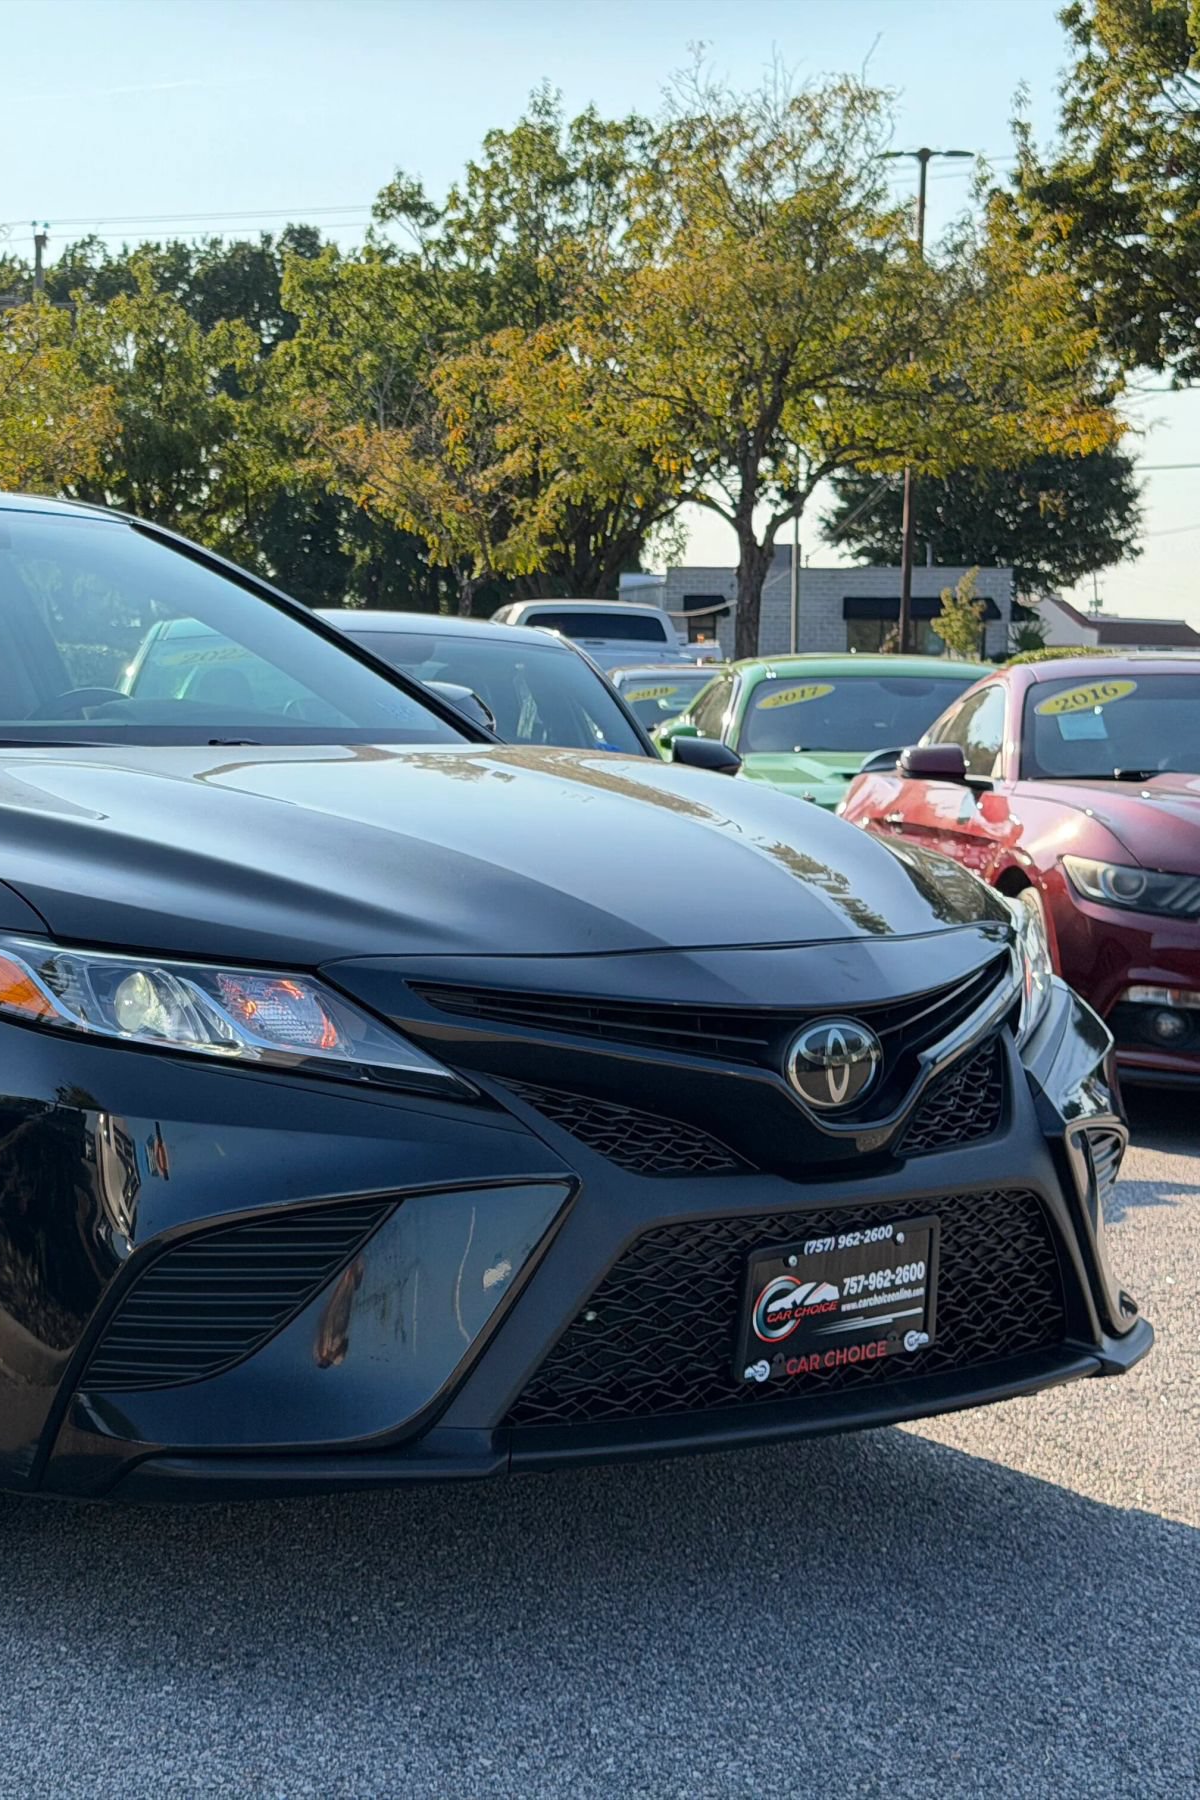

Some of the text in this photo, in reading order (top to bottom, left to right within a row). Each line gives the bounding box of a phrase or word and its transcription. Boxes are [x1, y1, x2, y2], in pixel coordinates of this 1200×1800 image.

[772, 686, 818, 706] 2017
[1054, 685, 1119, 711] 2016
[803, 1224, 893, 1256] (757) 962-2600
[842, 1260, 925, 1296] 757-962-2600
[766, 1300, 839, 1324] CAR CHOICE
[785, 1340, 888, 1376] CAR CHOICE
